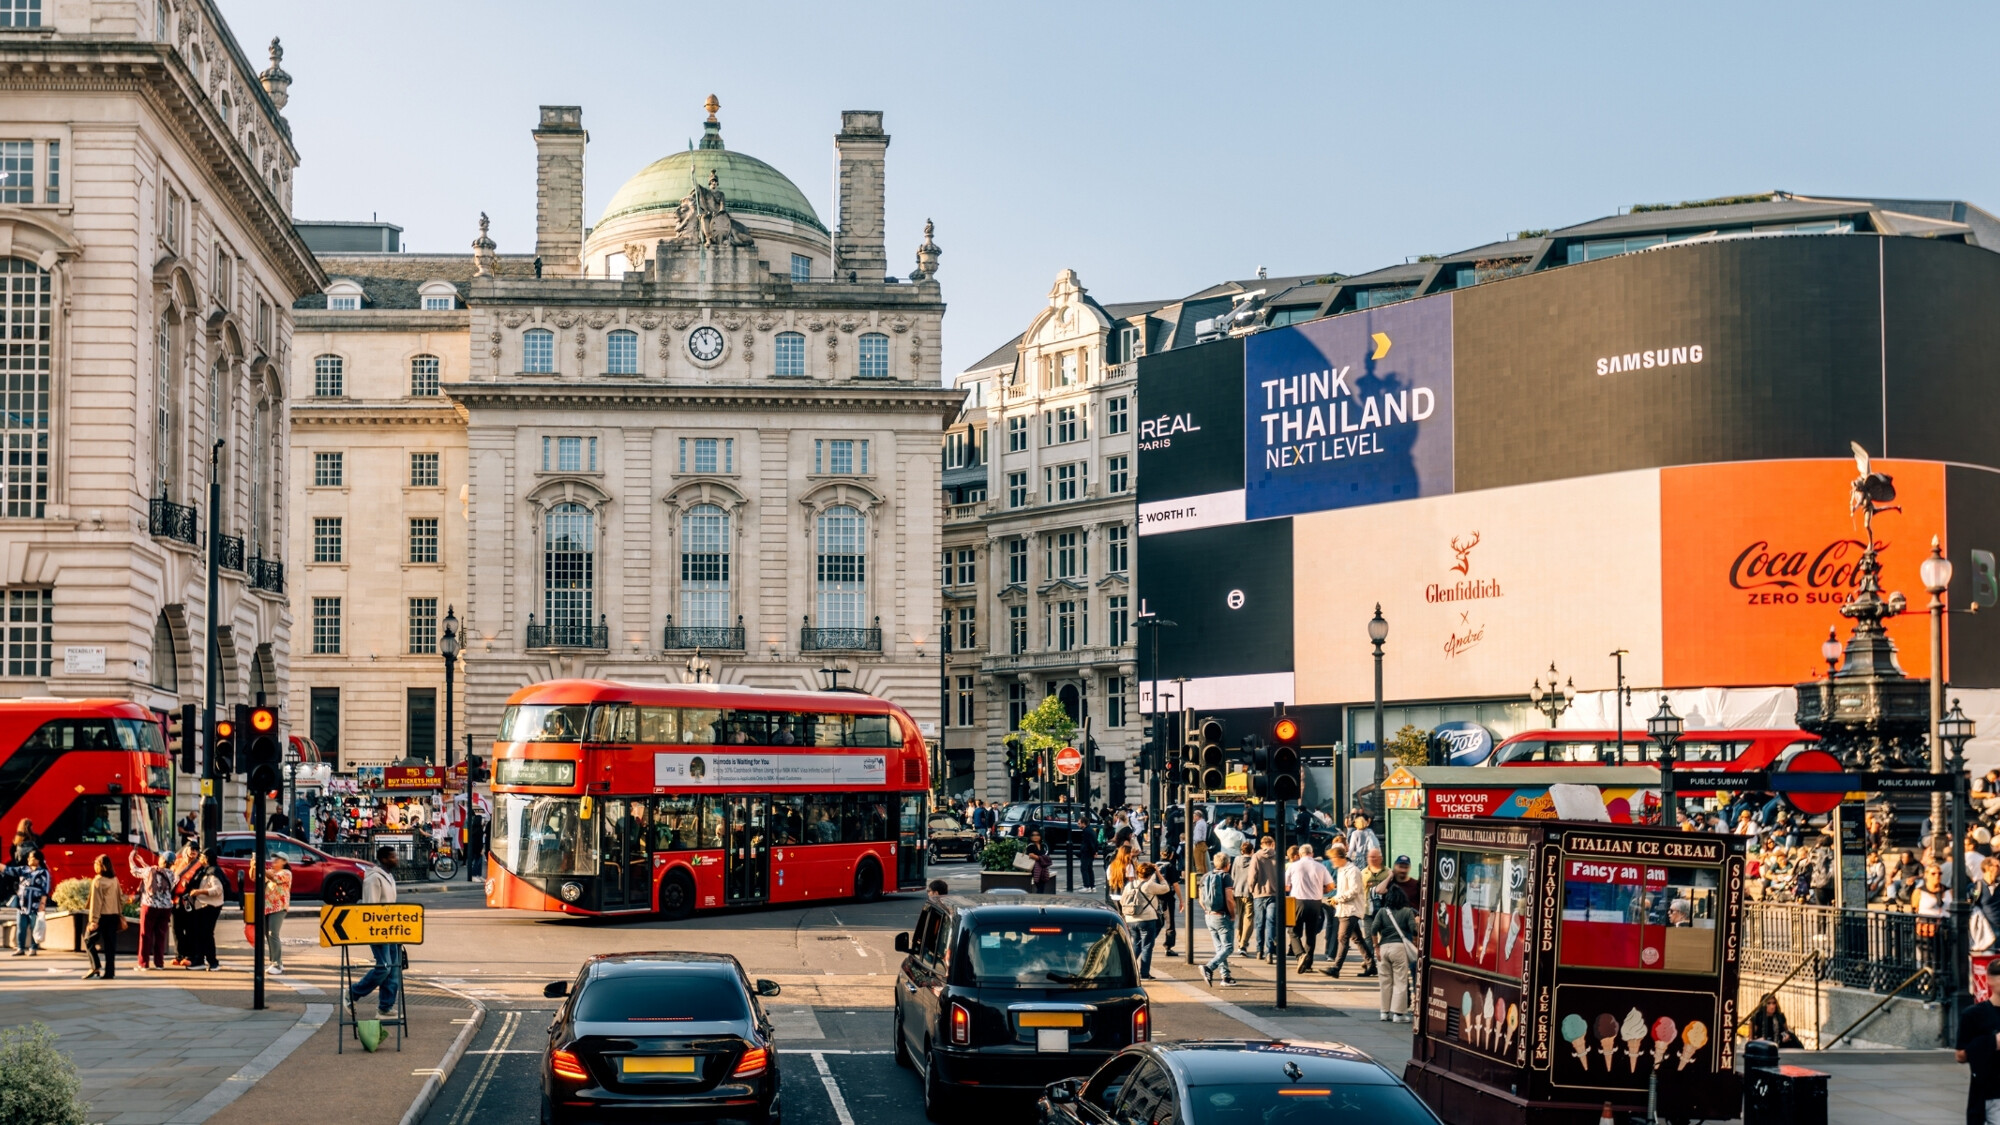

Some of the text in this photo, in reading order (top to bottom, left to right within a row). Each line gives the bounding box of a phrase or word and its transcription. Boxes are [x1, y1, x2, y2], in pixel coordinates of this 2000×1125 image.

[1597, 345, 1703, 376] SAMSUNG
[1261, 366, 1351, 410] THINK
[1139, 413, 1201, 440] RÉAL
[1261, 387, 1435, 446] THAILAND
[1139, 439, 1171, 451] PARIS
[1266, 432, 1384, 469] NEXT LEVEL
[1146, 509, 1183, 522] WORTH
[1186, 507, 1197, 517] IT.
[1729, 541, 1808, 590] Coca
[1426, 578, 1501, 603] Glenfiddich
[1748, 592, 1861, 604] ZERO SUGA
[1444, 624, 1485, 660] André
[1436, 729, 1483, 760] Boots
[558, 764, 570, 780] 19
[1905, 779, 1936, 787] SUBWAY
[1436, 794, 1488, 803] BUY YOUR
[1440, 803, 1484, 812] TICKETS
[1515, 796, 1533, 808] City
[1440, 828, 1528, 844] TRADITIONAL ITALIAN ICE CREAM
[1571, 837, 1716, 858] ITALIAN ICE CREAM
[1422, 837, 1430, 899] SOFT
[1572, 862, 1666, 883] Fancy an am
[1524, 849, 1535, 953] FLAVOURED
[1542, 855, 1556, 951] FLAVOURED
[1730, 864, 1741, 917] SOFT
[363, 912, 418, 922] Diverted
[369, 925, 411, 935] traffic
[1727, 922, 1737, 961] ICE
[1413, 957, 1423, 1029] CREAM
[1539, 986, 1549, 1013] ICE
[1517, 1000, 1527, 1061] CREAM
[1536, 1014, 1549, 1059] CREAM
[1721, 999, 1733, 1069] CREAM
